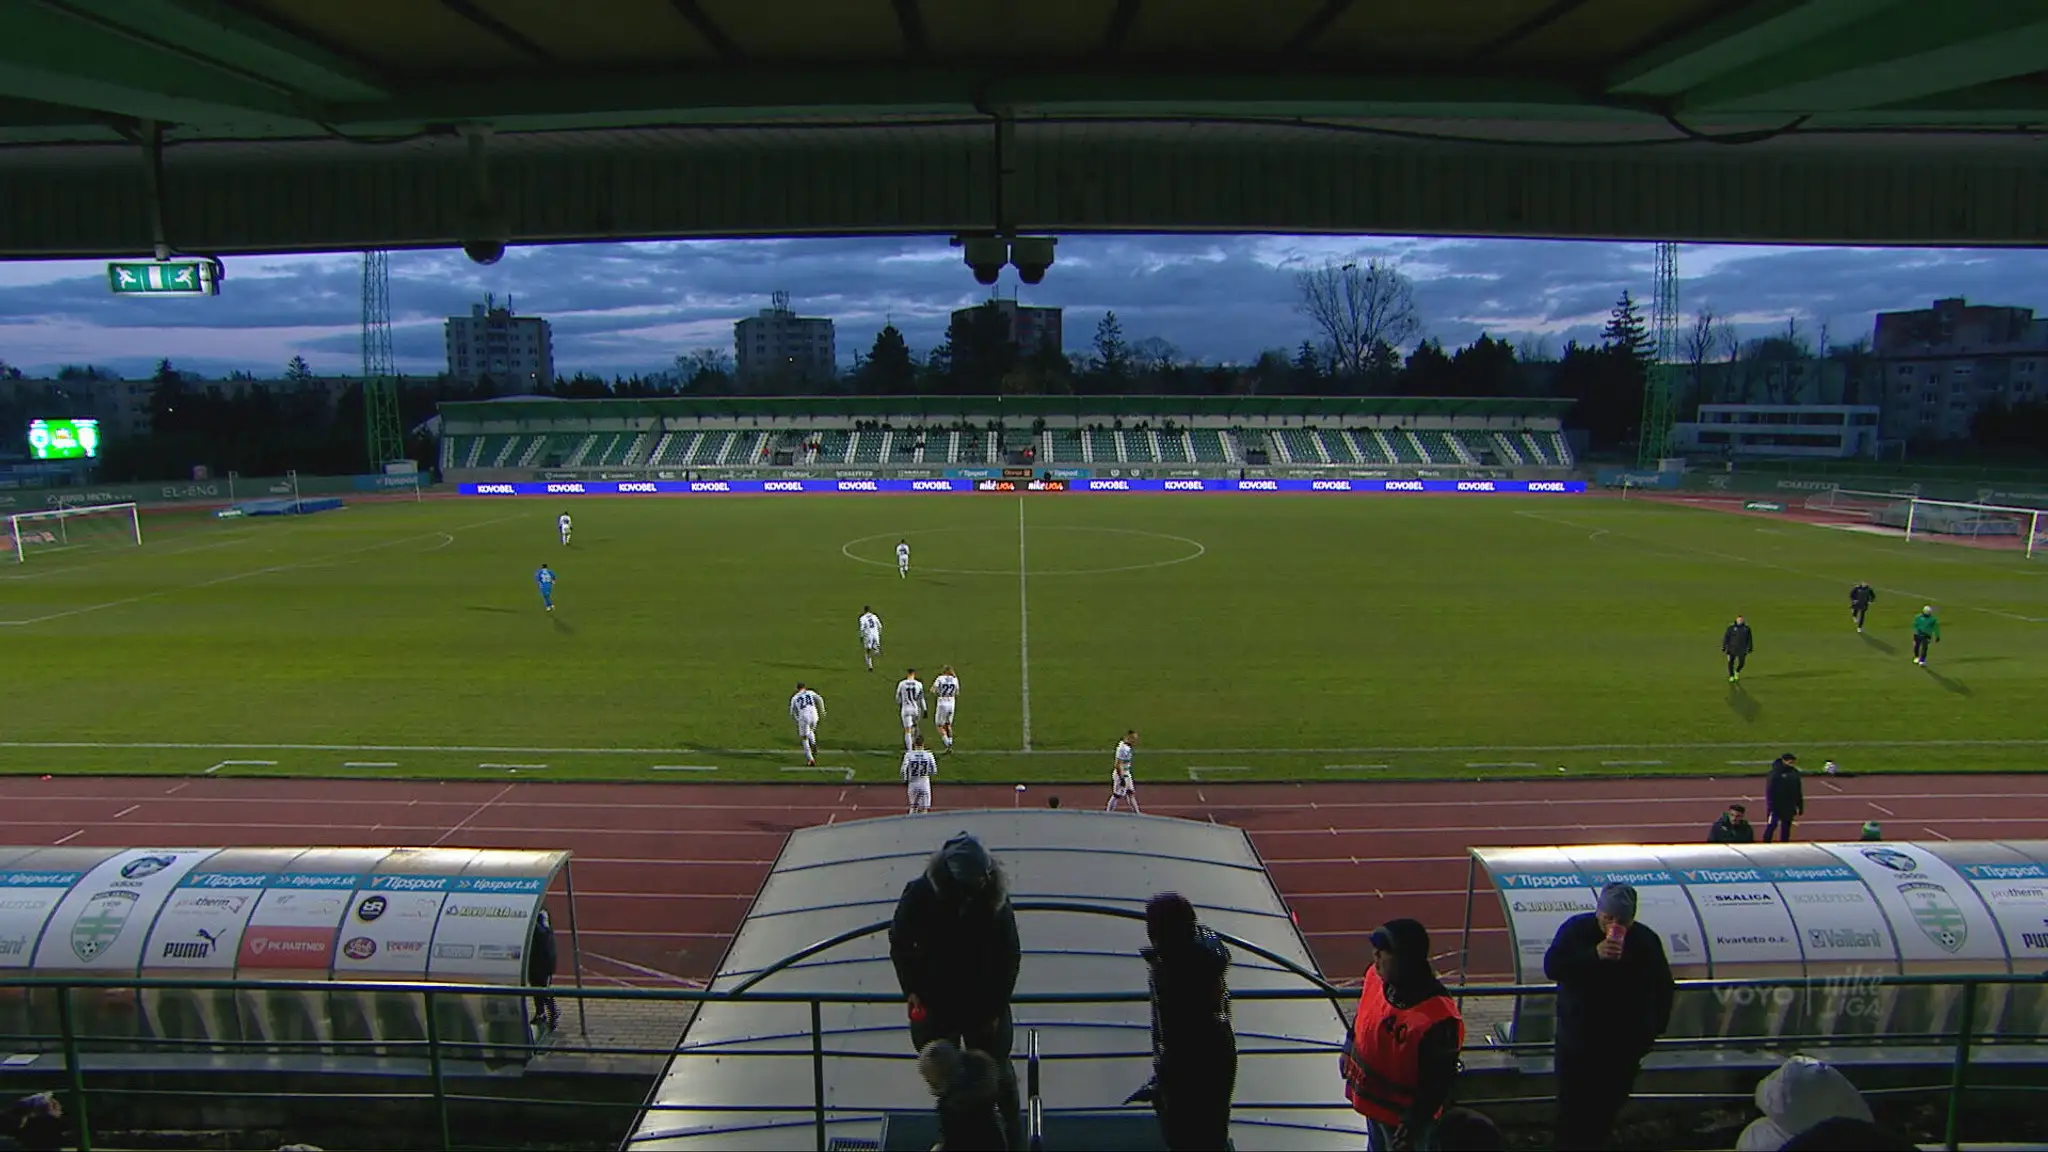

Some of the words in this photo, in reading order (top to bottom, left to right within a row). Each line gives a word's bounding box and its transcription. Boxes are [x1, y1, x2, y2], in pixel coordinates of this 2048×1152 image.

[477, 484, 515, 493] KOVOBEL
[547, 484, 584, 492] KOVOBEL
[618, 483, 656, 492] KOVOBEL
[691, 482, 730, 492] KOVOBEL
[764, 482, 803, 491] KOVOBEL
[838, 482, 877, 491] KOVOBEL
[912, 481, 952, 490] KOVOBEL
[1090, 480, 1129, 490] KOVOBEL
[1164, 480, 1204, 490] KOVOBEL
[1238, 480, 1277, 490] KOVOBEL
[1312, 481, 1351, 490] KOVOBEL
[1385, 481, 1424, 490] KOVOBEL
[1458, 482, 1495, 491] KOVOBEL
[1528, 482, 1565, 491] KOVOBEL
[1698, 870, 1760, 882] Tipsport
[1785, 868, 1850, 880] tipsport.sk
[1983, 865, 2045, 878] Tipsport
[204, 874, 267, 887] Tipsport
[1520, 874, 1581, 887] Tipsport
[1606, 872, 1672, 884] tipsport.sk
[384, 877, 448, 890] Tipsport
[473, 879, 540, 890] tipsport.sk
[1717, 936, 1766, 944] Kvarteto
[1824, 928, 1882, 949] Vaillant
[162, 943, 209, 958] PUMA
